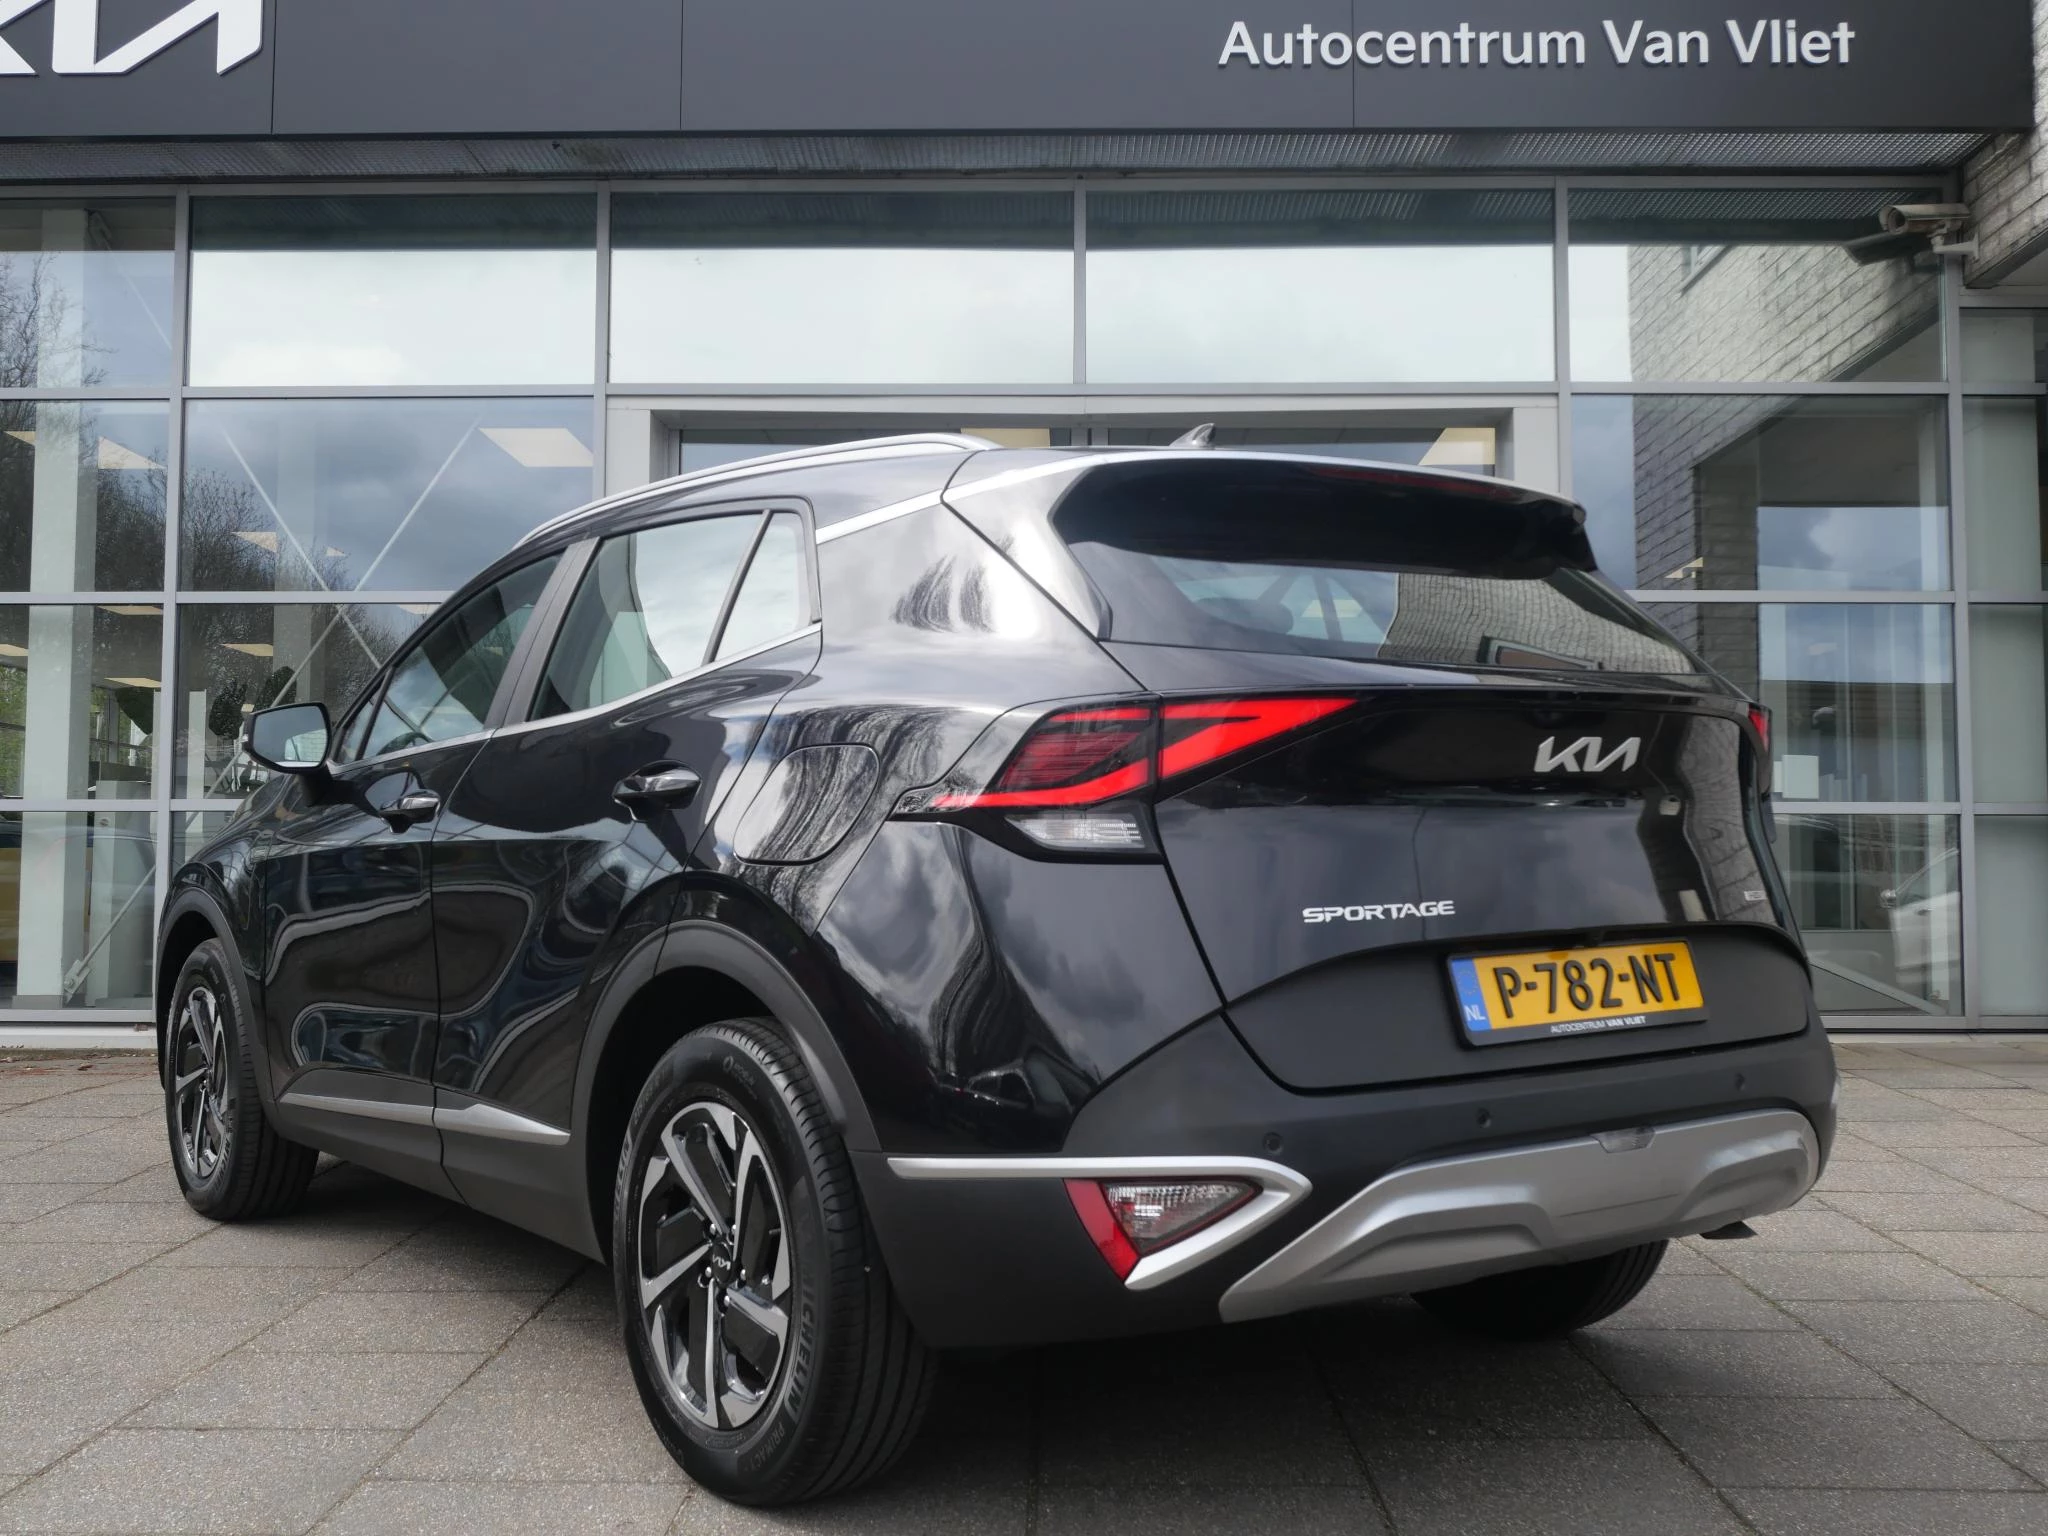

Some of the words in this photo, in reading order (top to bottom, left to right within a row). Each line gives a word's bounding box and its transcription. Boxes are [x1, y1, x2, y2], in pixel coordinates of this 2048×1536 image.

[0, 0, 263, 75] IA
[1218, 21, 1586, 67] Autocentrum
[1602, 20, 1710, 64] Van
[1726, 18, 1855, 64] Vliet
[1534, 736, 1640, 772] KIA
[1302, 900, 1455, 923] SPORTAGE
[1493, 953, 1680, 1018] P-782-NT
[1463, 1003, 1487, 1022] NL
[1606, 1017, 1624, 1027] VAN
[1624, 1015, 1646, 1025] VLIET
